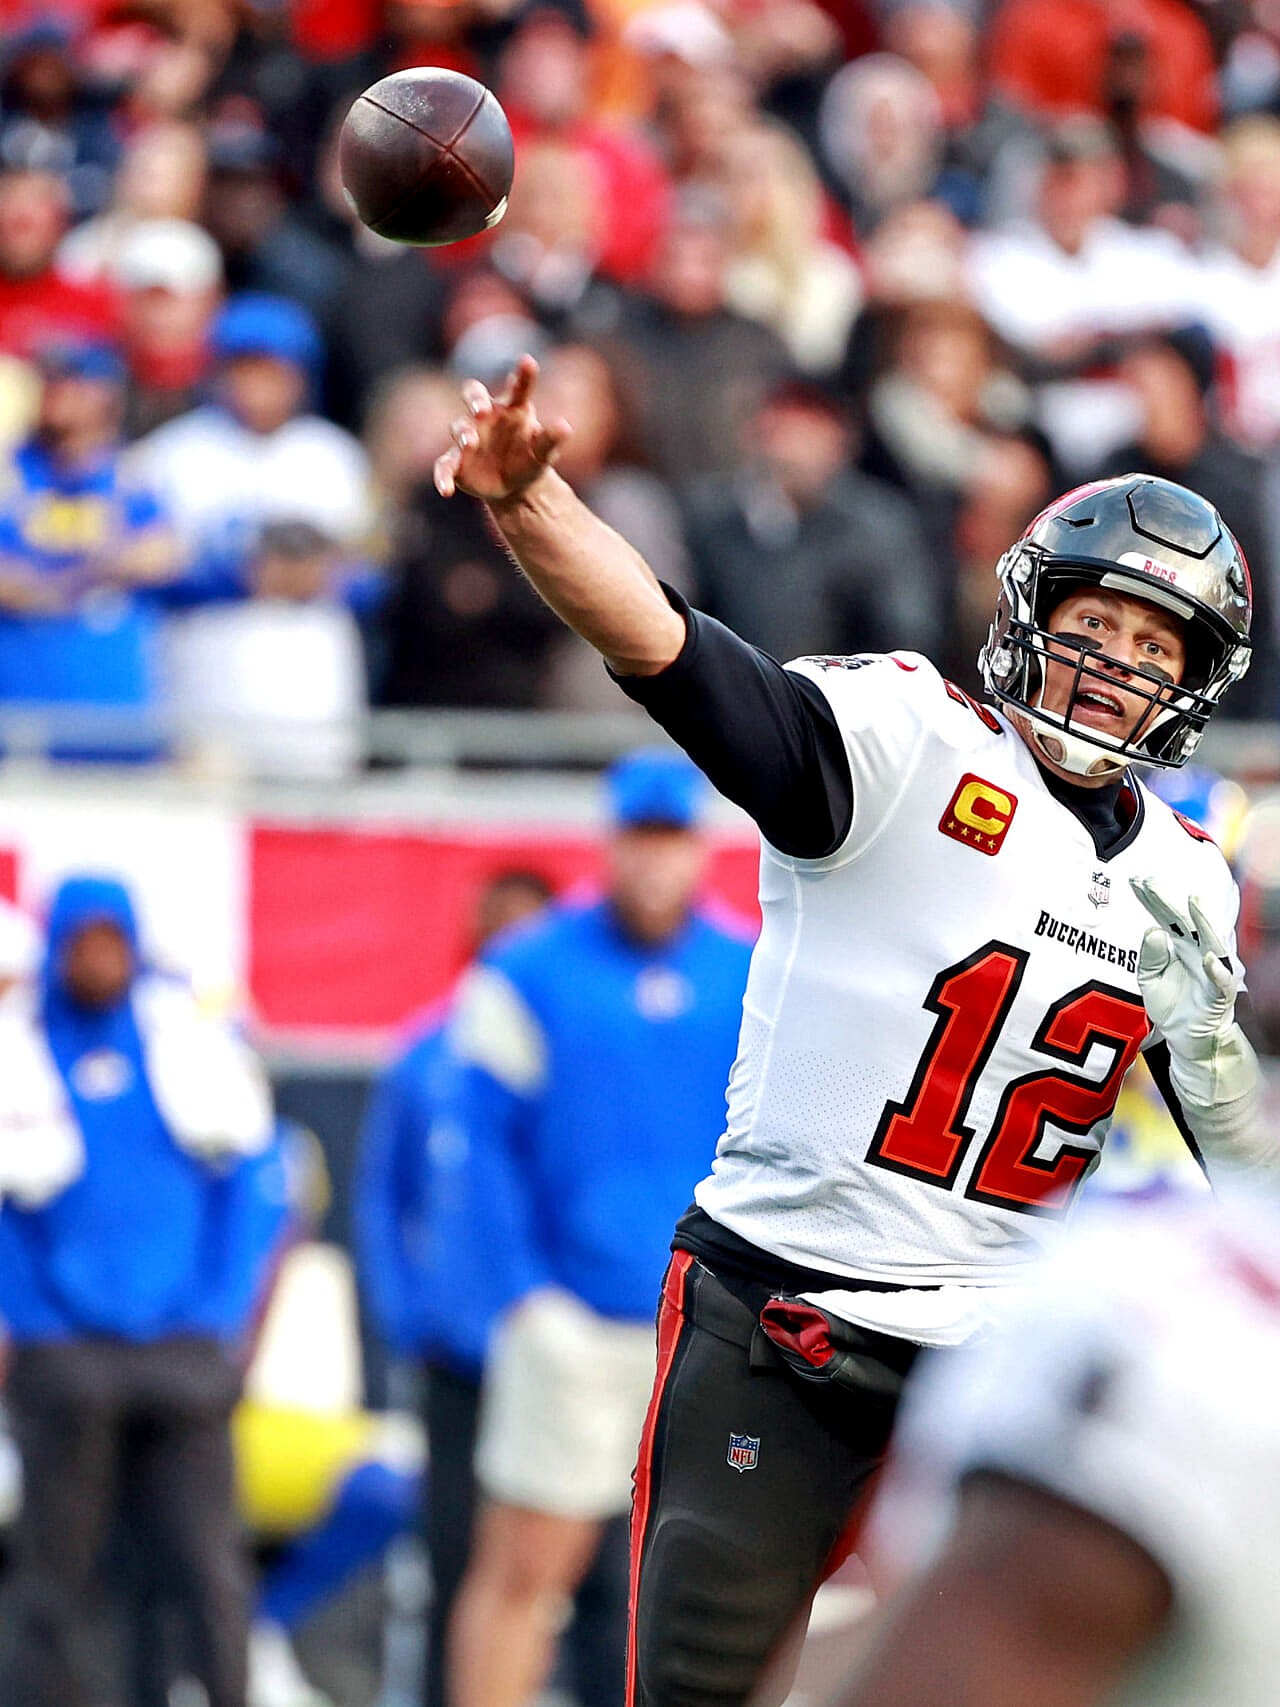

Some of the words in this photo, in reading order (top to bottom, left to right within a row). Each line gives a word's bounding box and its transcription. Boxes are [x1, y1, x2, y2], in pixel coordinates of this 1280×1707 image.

[953, 781, 1012, 836] C
[1034, 909, 1138, 973] BUCCANEERS
[864, 939, 1153, 1222] 12
[731, 1447, 754, 1465] NFL
